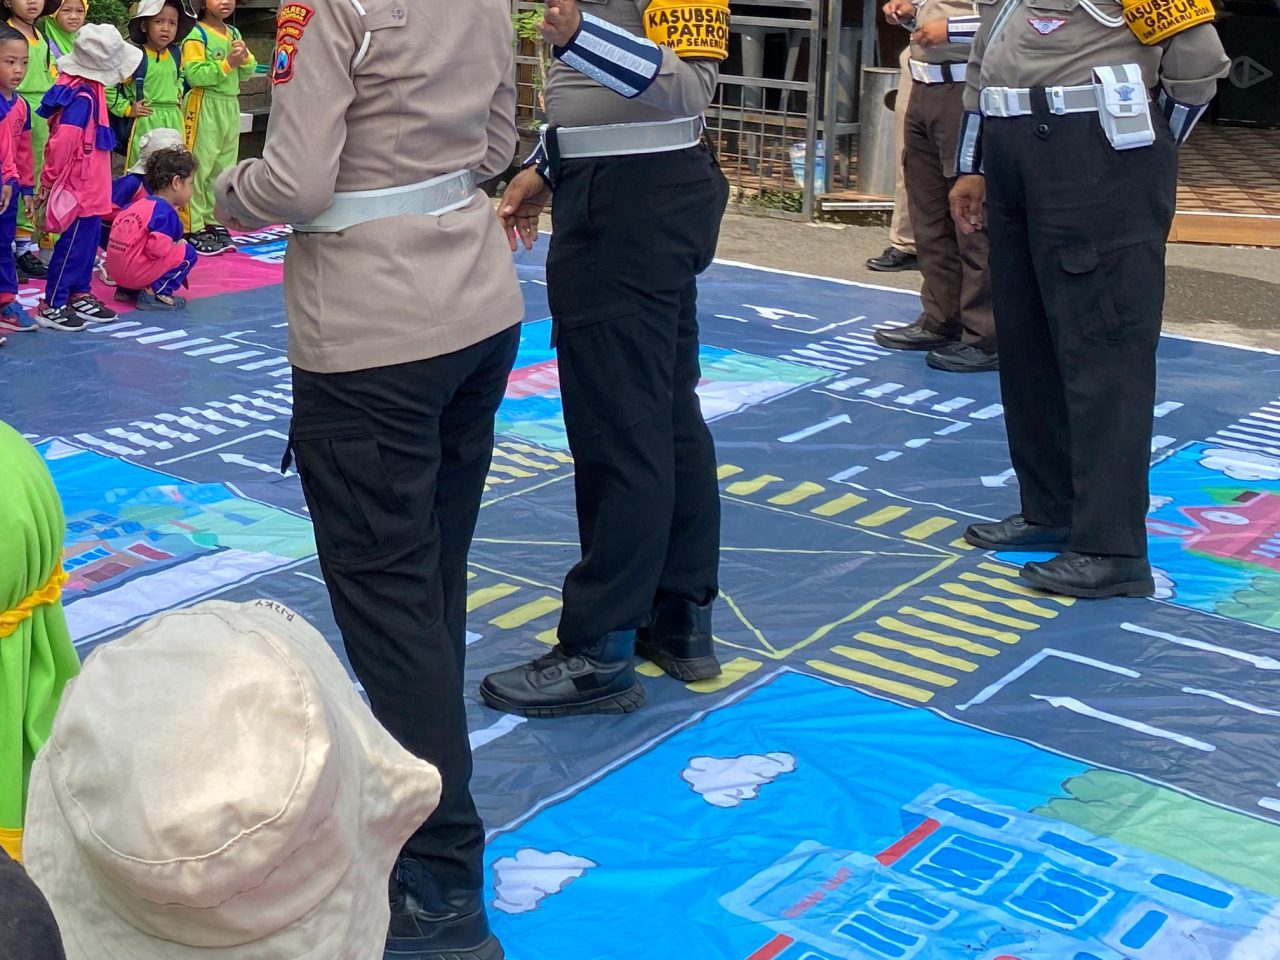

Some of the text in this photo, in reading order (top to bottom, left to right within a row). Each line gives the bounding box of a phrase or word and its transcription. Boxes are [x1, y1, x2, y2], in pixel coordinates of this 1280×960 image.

[1144, 0, 1198, 28] GATUR
[1157, 13, 1193, 32] SEMERU
[686, 38, 724, 49] SEMERU
[254, 599, 295, 622] RIZKY
